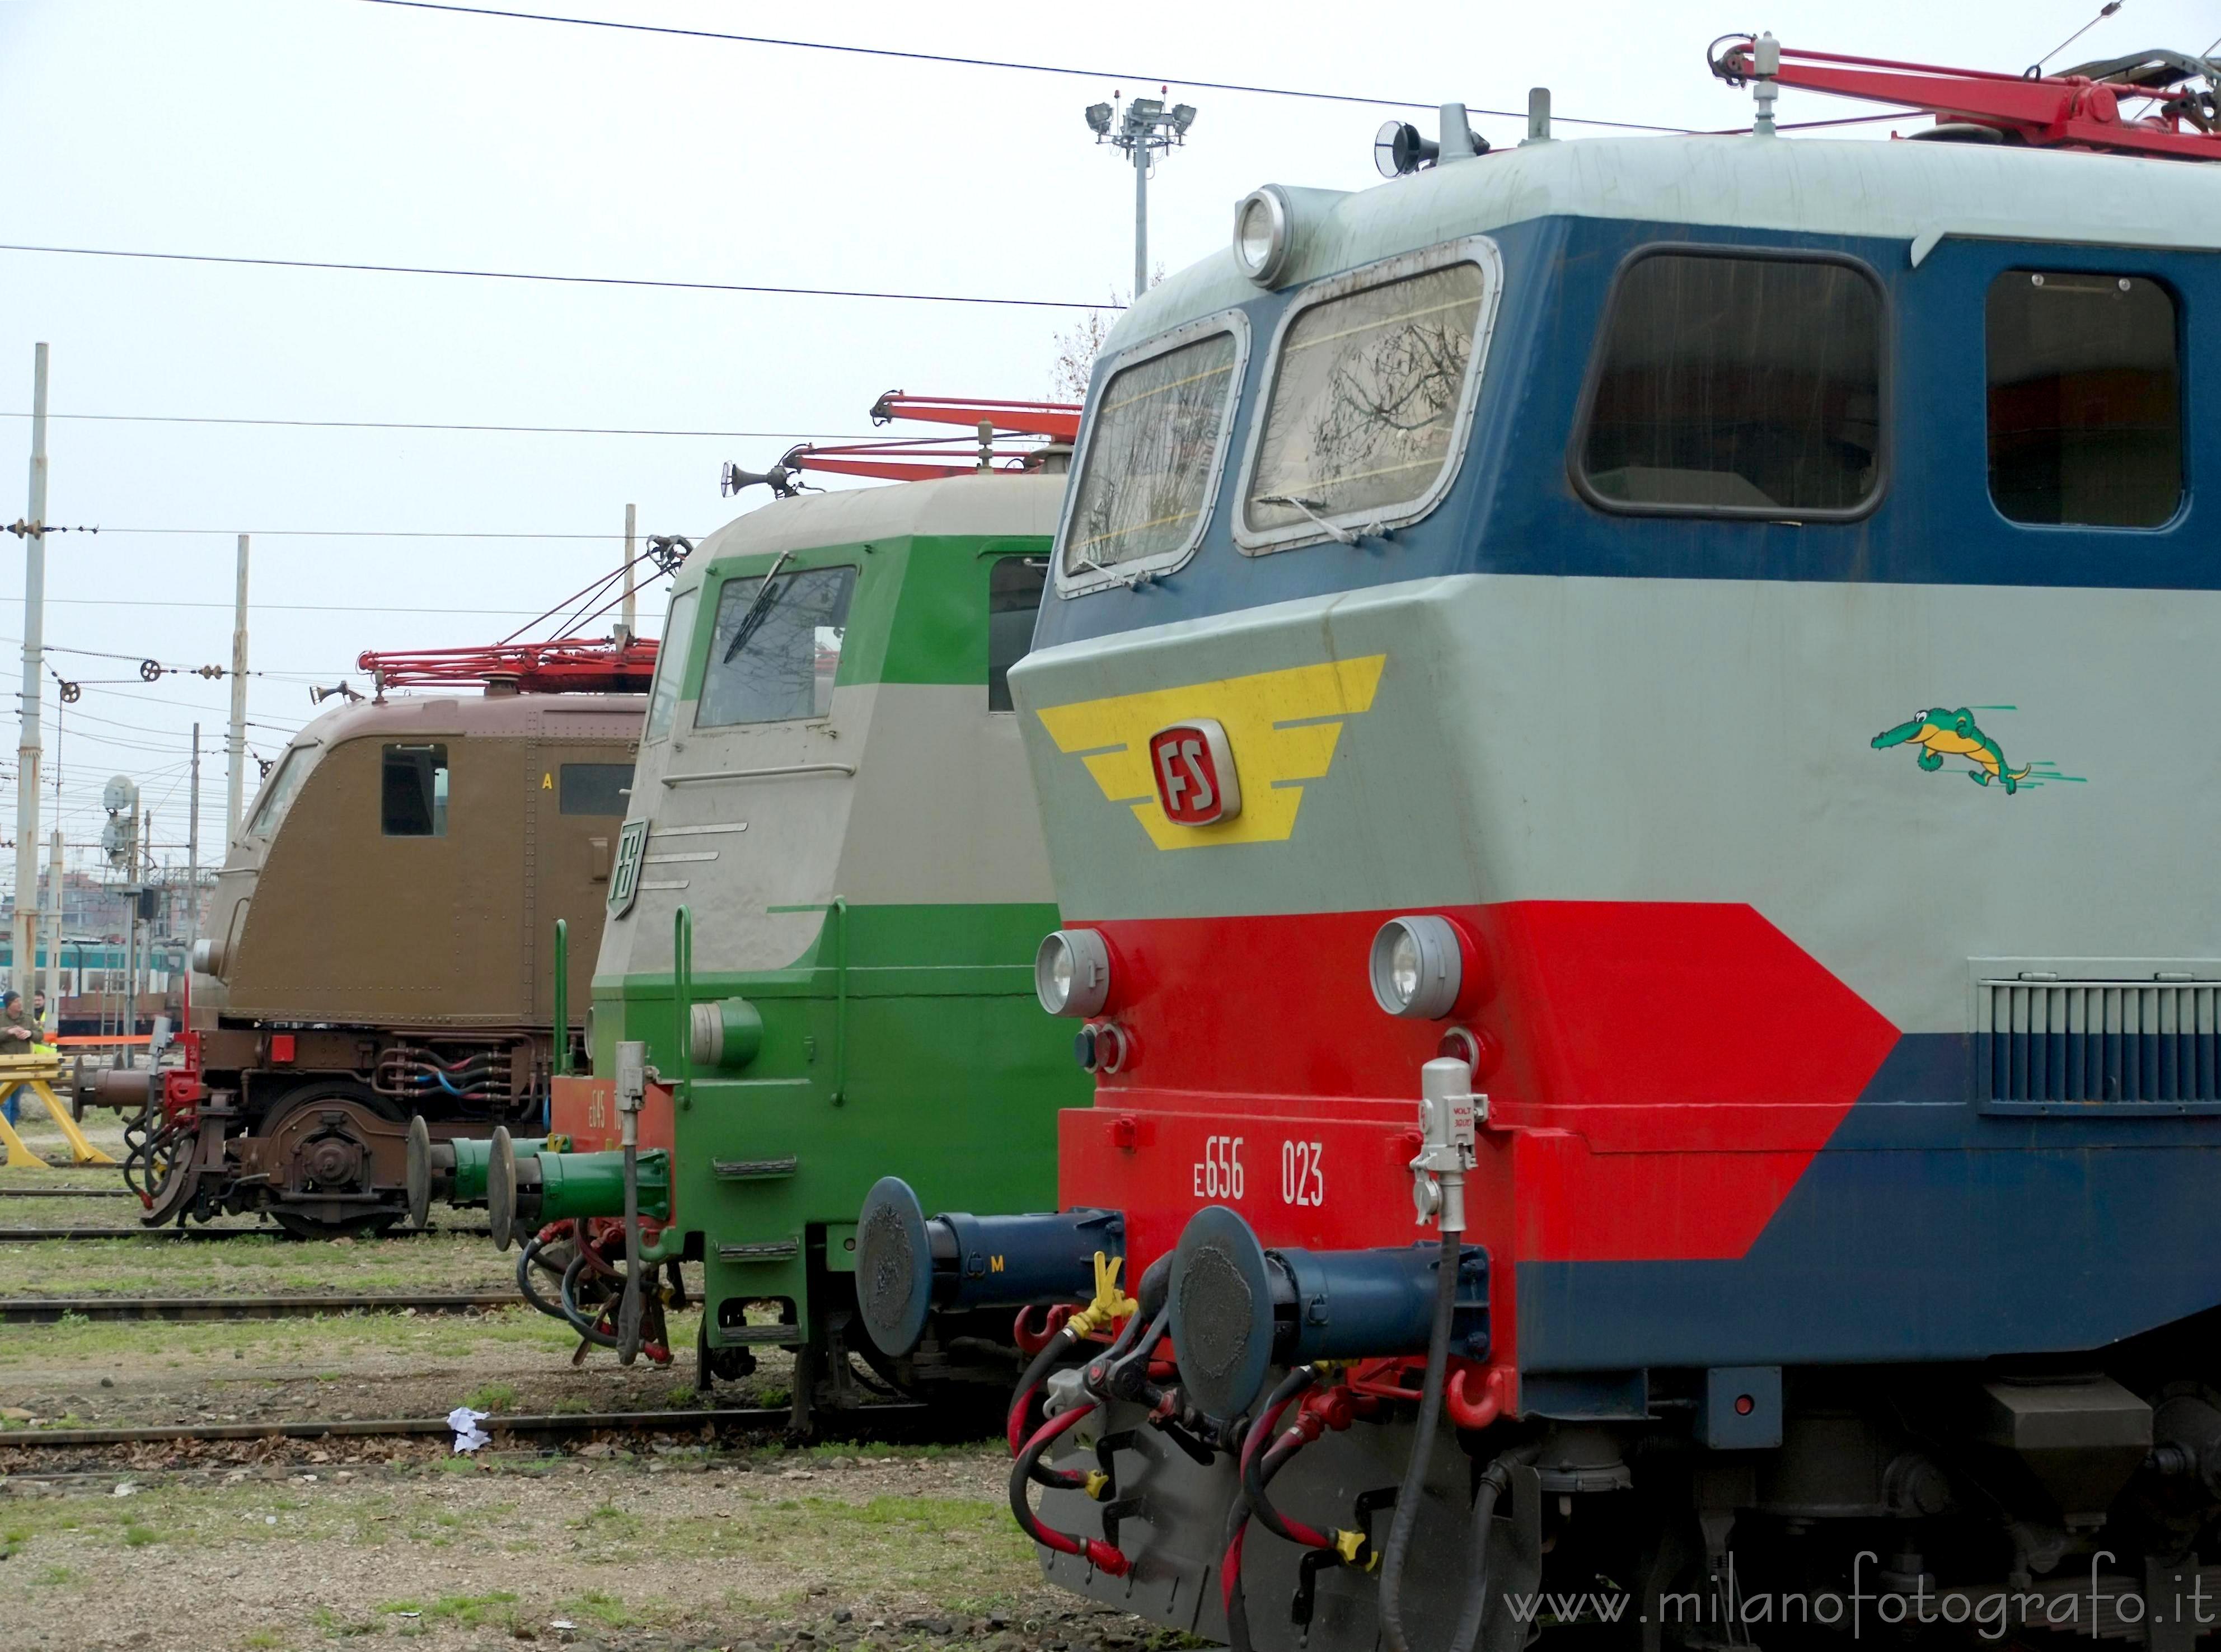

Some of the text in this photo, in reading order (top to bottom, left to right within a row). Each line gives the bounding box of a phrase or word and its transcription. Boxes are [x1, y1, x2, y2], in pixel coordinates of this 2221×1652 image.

[542, 773, 552, 789] A
[1158, 740, 1213, 811] FS
[610, 830, 641, 900] FS
[589, 1090, 605, 1129] E645
[1194, 1136, 1323, 1207] E656 023
[991, 1255, 1004, 1273] M
